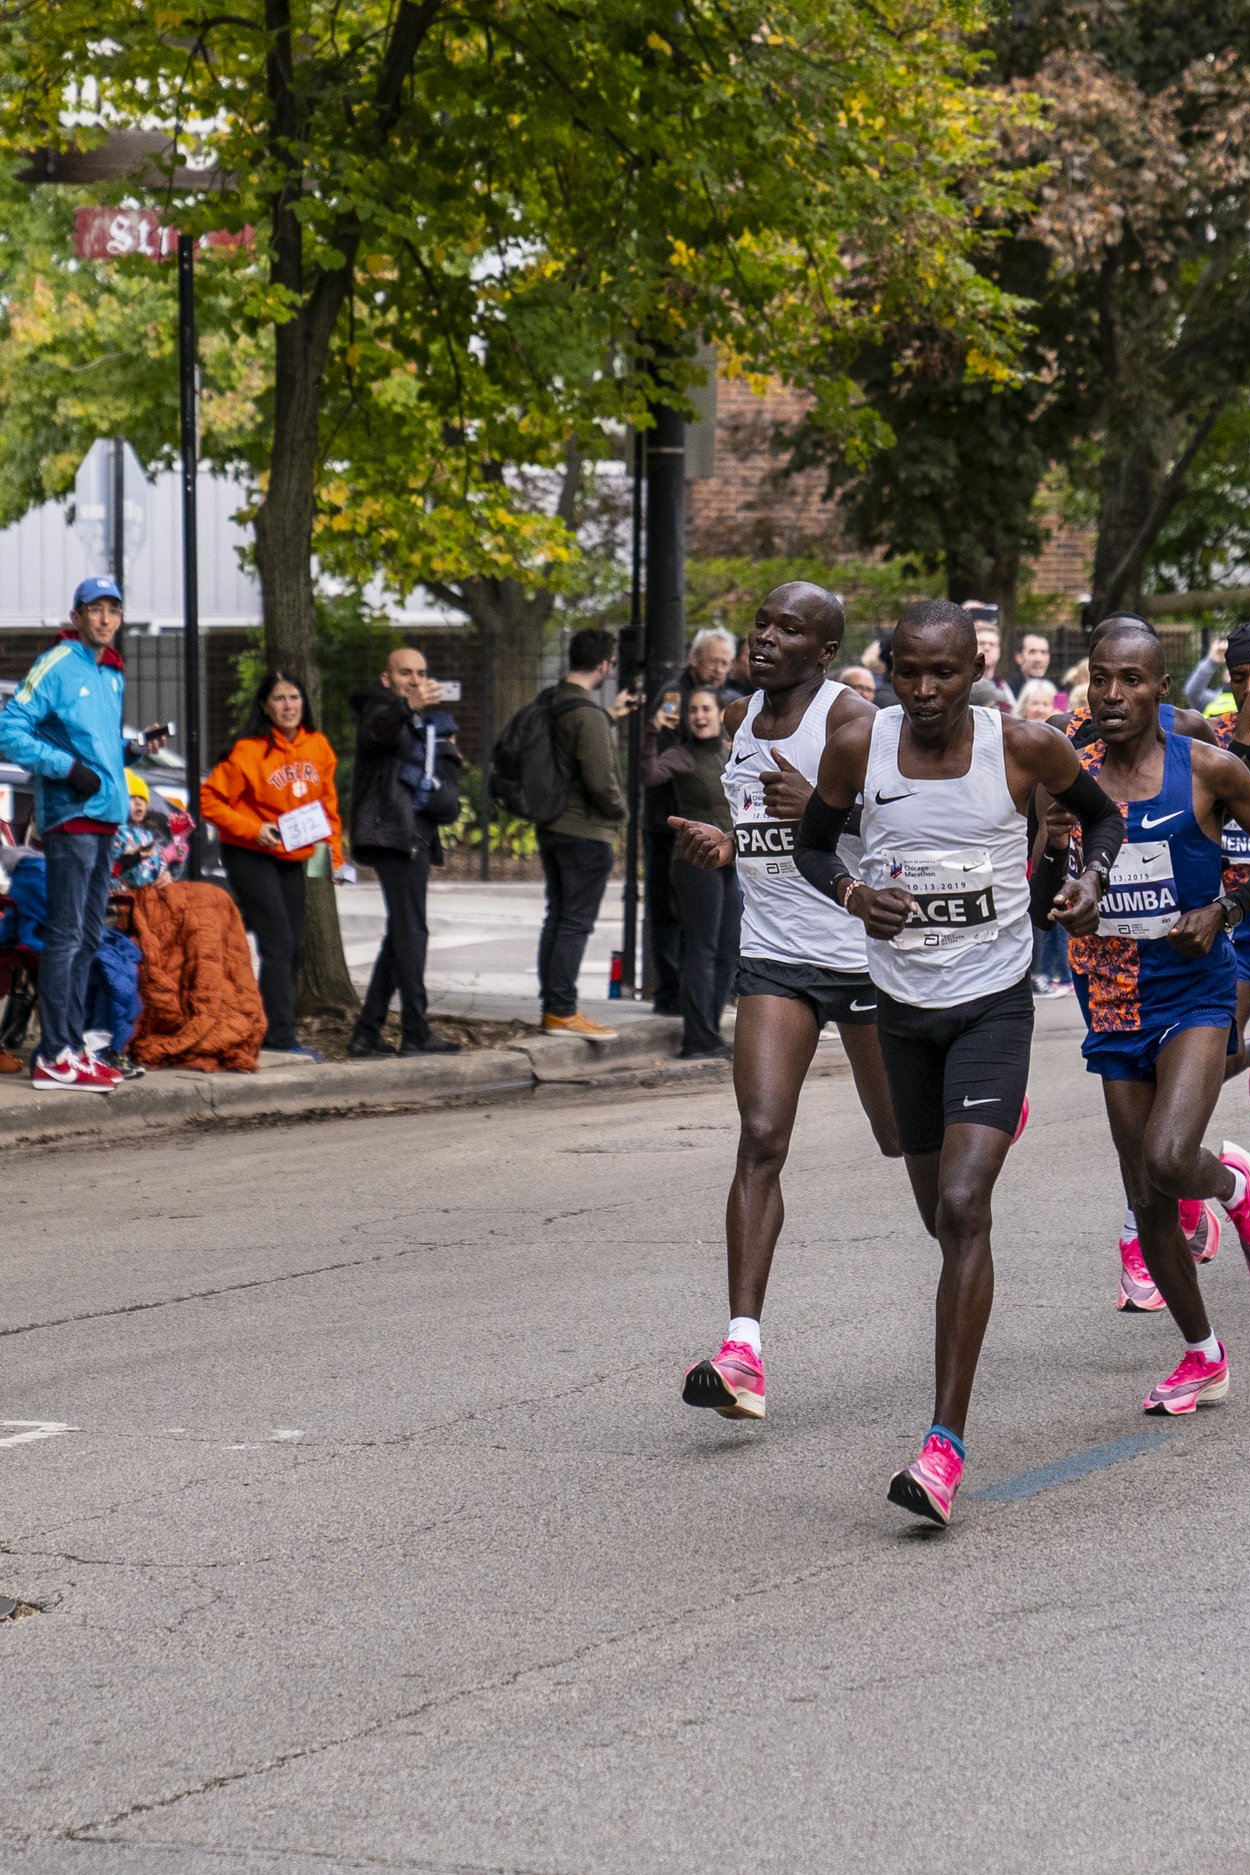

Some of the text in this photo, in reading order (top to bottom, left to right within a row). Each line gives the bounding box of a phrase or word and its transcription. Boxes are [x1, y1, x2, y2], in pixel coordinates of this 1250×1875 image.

[267, 760, 320, 790] TIGERS
[736, 828, 795, 852] PACE
[906, 881, 966, 891] 10.13.2019
[1113, 873, 1150, 882] 13.2019
[906, 894, 990, 923] ACE 1
[1098, 887, 1176, 913] HUMBA
